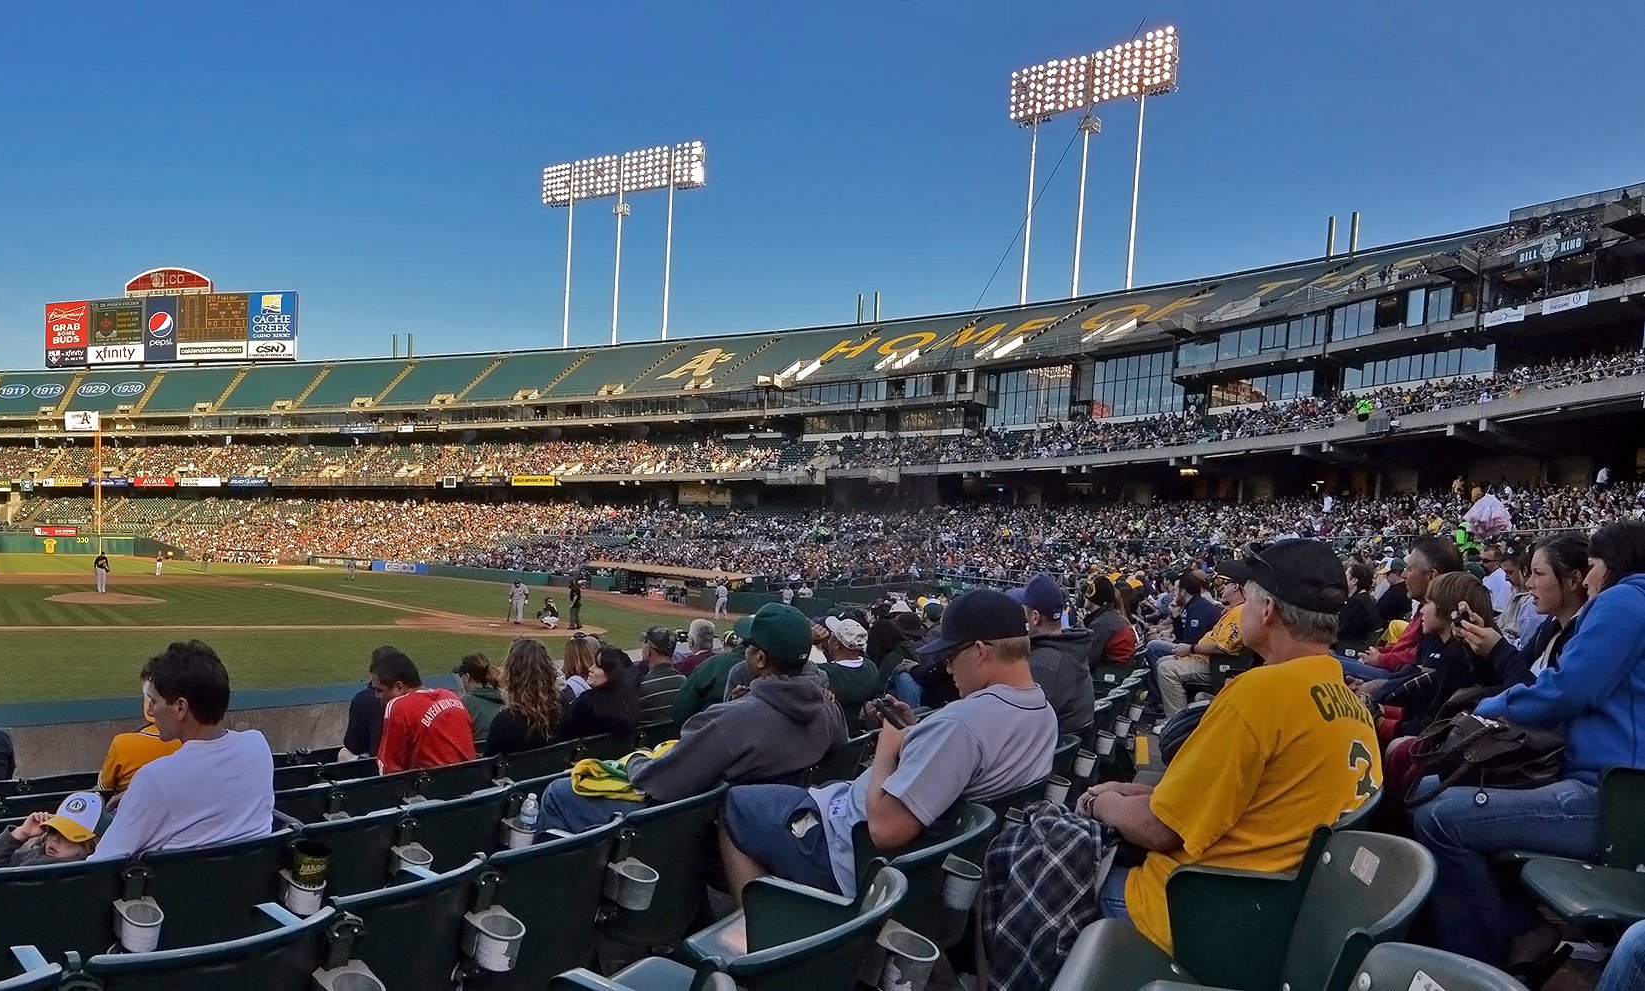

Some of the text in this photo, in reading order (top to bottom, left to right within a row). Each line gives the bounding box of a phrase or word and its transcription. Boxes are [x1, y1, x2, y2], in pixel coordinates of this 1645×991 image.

[1519, 251, 1538, 263] BILL
[1560, 238, 1582, 252] KING
[252, 314, 291, 323] CACHE
[53, 323, 80, 332] GRAB
[252, 324, 291, 333] CREEK
[820, 316, 1058, 361] HOME
[1081, 294, 1214, 330] OF
[53, 336, 80, 344] BUDS
[149, 338, 173, 347] pepsi
[96, 346, 135, 361] xfinity
[180, 346, 242, 354] oaklandathletics.com
[256, 345, 280, 353] CSN
[2, 387, 27, 395] 1911
[36, 387, 62, 395] 1913
[80, 384, 106, 393] 1929
[116, 384, 142, 393] 1930
[385, 563, 416, 573] GEICO
[1310, 682, 1374, 730] CHAVE
[421, 702, 443, 728] BAYERN
